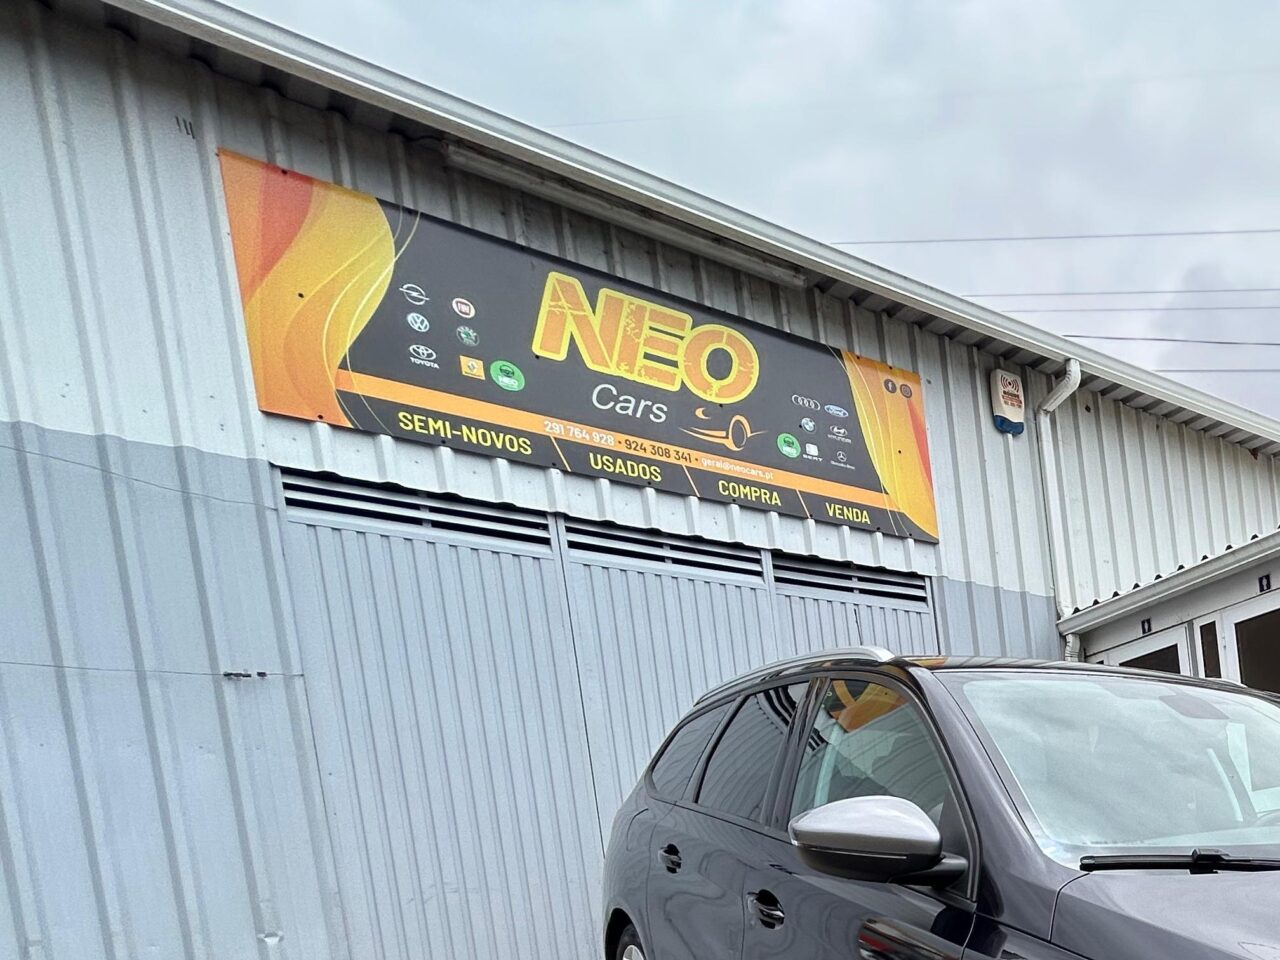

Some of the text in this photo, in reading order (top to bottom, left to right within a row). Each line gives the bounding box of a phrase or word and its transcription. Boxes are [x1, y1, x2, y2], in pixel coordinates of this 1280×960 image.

[532, 271, 759, 404] NEO
[410, 357, 440, 369] TOYOTA
[592, 383, 668, 423] Cars
[398, 411, 532, 455] SEMI-NOVOS
[544, 420, 774, 480] 291 764 928 924 308 341 geral@neocars.pt
[589, 452, 662, 482] USADOS
[718, 480, 782, 507] COMPRA
[825, 502, 871, 525] VENDA
